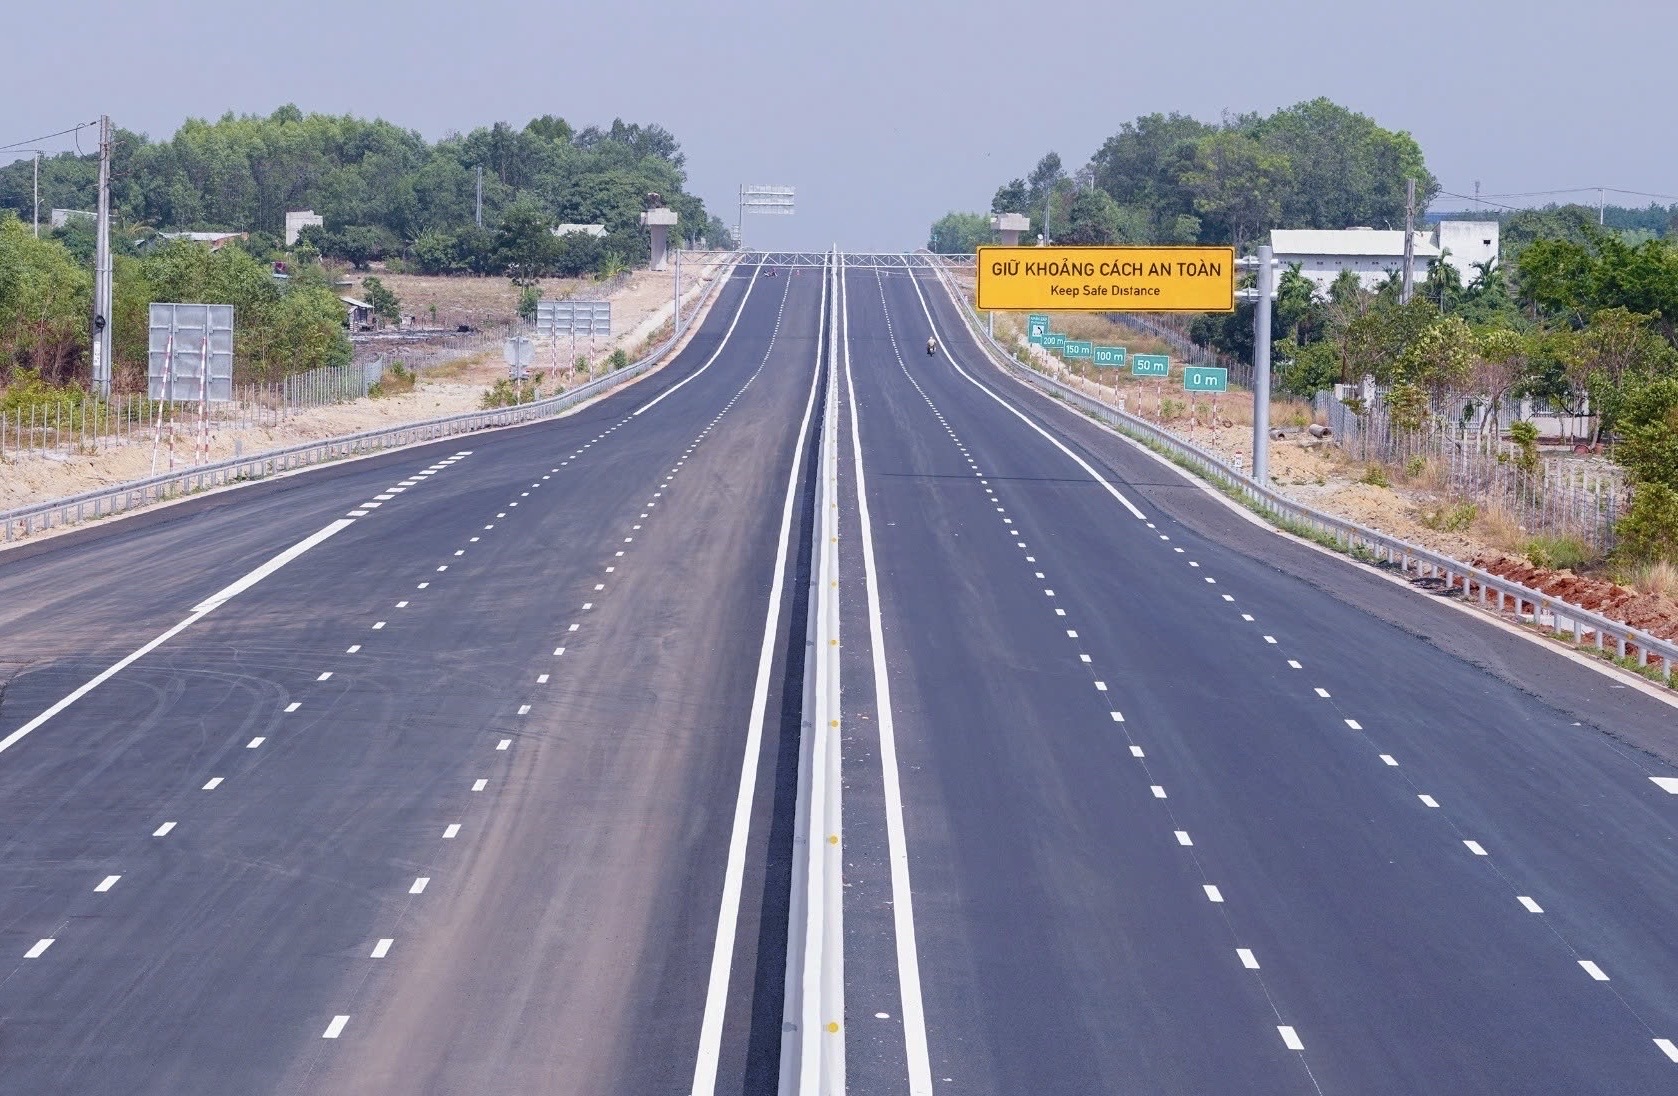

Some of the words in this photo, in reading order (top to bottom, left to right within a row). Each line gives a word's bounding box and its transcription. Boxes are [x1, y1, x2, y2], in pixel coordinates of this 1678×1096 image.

[992, 258, 1020, 276] GIỮ
[1025, 258, 1095, 276] KHOẢNG
[1100, 259, 1142, 276] CÁCH
[1148, 262, 1172, 276] AN
[1177, 259, 1220, 276] TOÀN
[1050, 284, 1080, 298] Keep
[1082, 284, 1108, 296] Safe
[1112, 284, 1160, 296] Distance
[1043, 336, 1056, 345] 200
[1066, 344, 1080, 354] 150
[1096, 352, 1112, 360] 100
[1137, 360, 1150, 370] 50
[1154, 362, 1164, 371] m
[1193, 374, 1201, 385] 0
[1204, 376, 1218, 385] m
